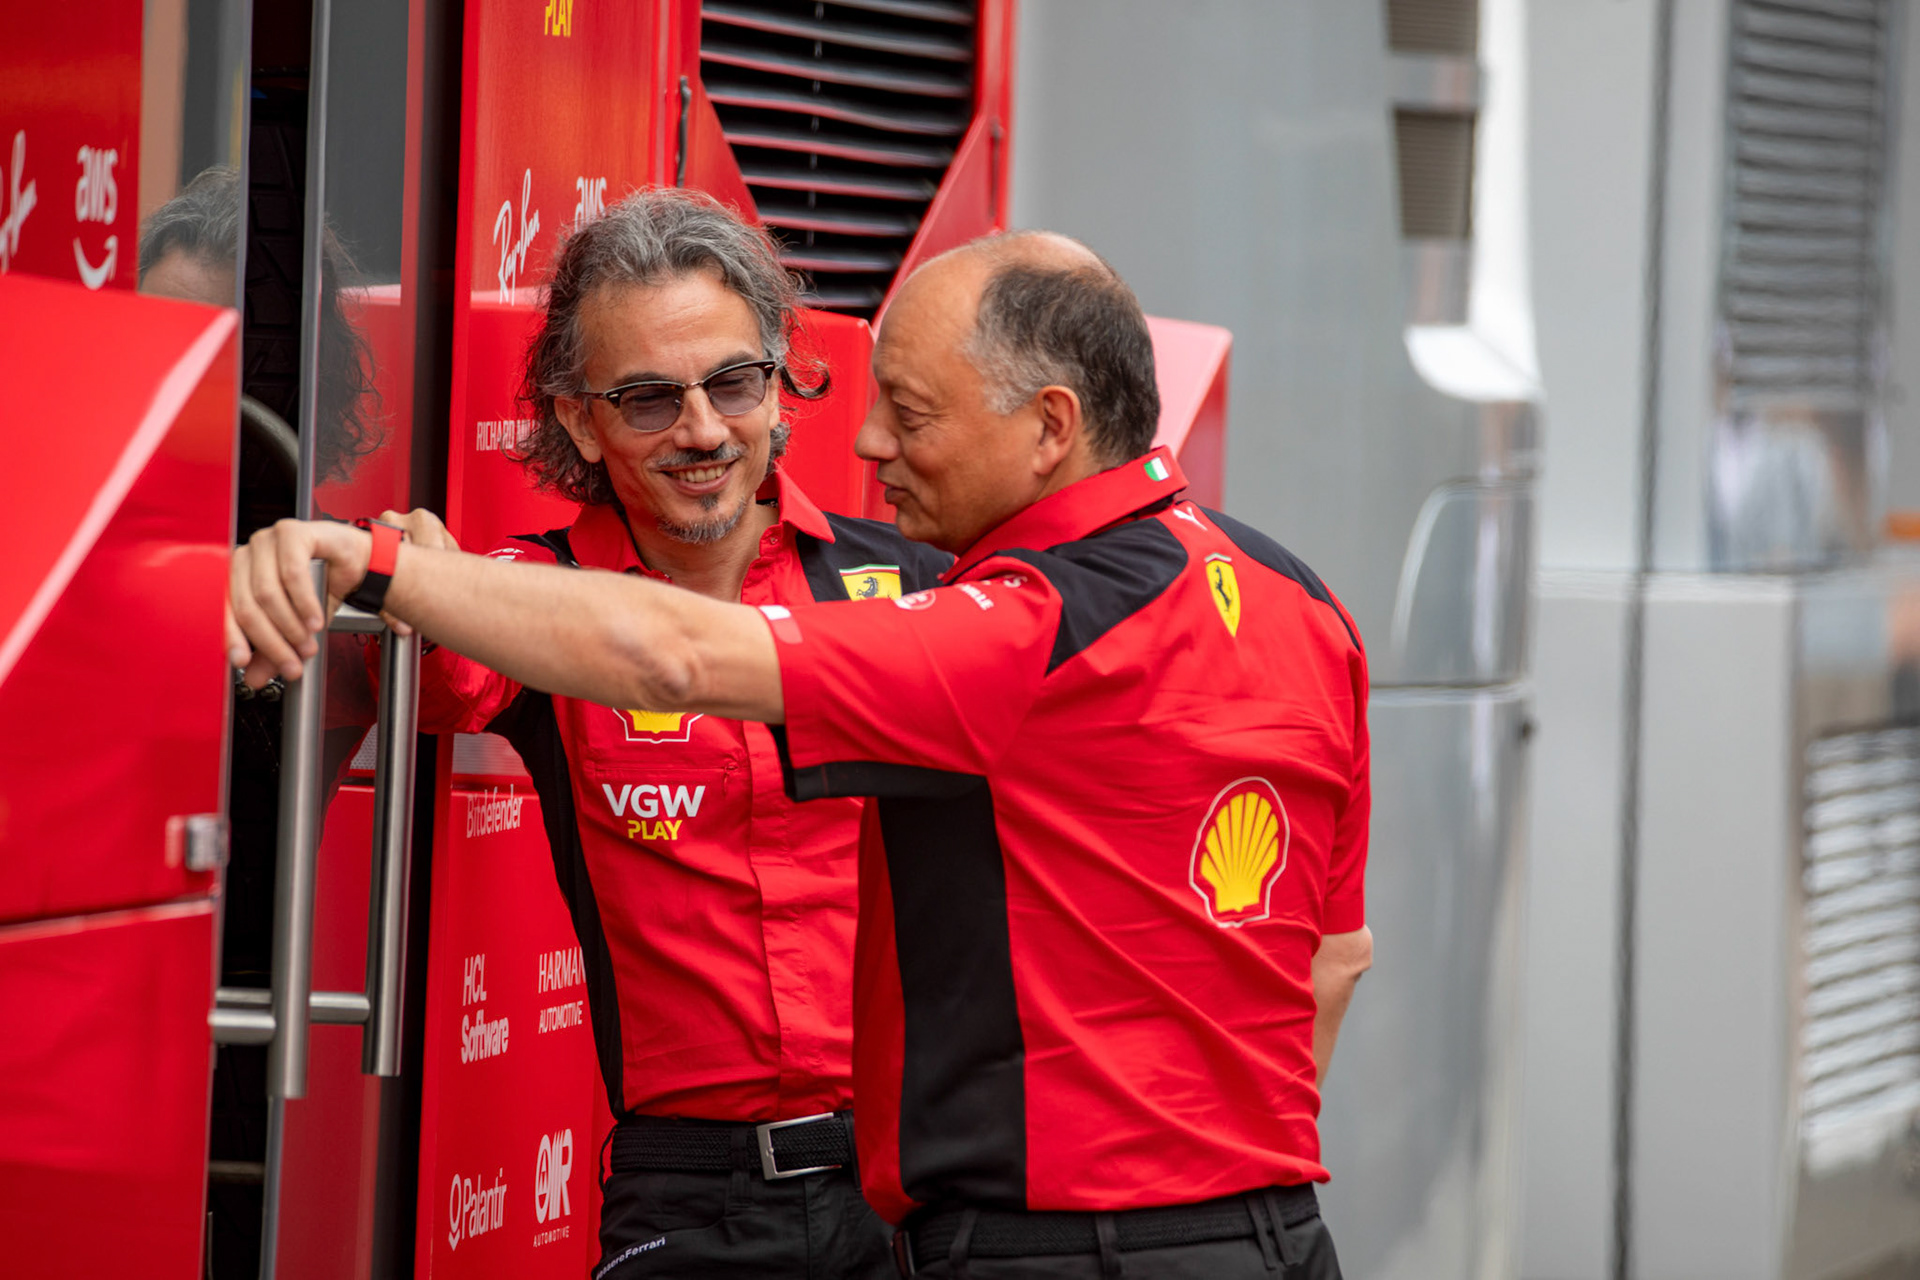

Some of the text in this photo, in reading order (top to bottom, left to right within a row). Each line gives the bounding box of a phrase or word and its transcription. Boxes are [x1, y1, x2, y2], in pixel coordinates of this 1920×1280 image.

[75, 144, 118, 225] aws
[476, 420, 515, 451] RICHARD
[466, 783, 523, 839] Bitdefender
[601, 783, 706, 818] VGW
[627, 819, 683, 841] PLAY
[462, 953, 487, 1006] HCL
[538, 946, 587, 994] HARMAN
[460, 1009, 510, 1064] Software
[538, 1000, 583, 1034] AUTOMOTIVE
[461, 1167, 508, 1240] Palantir
[533, 1225, 570, 1248] AUTOMOTIVE
